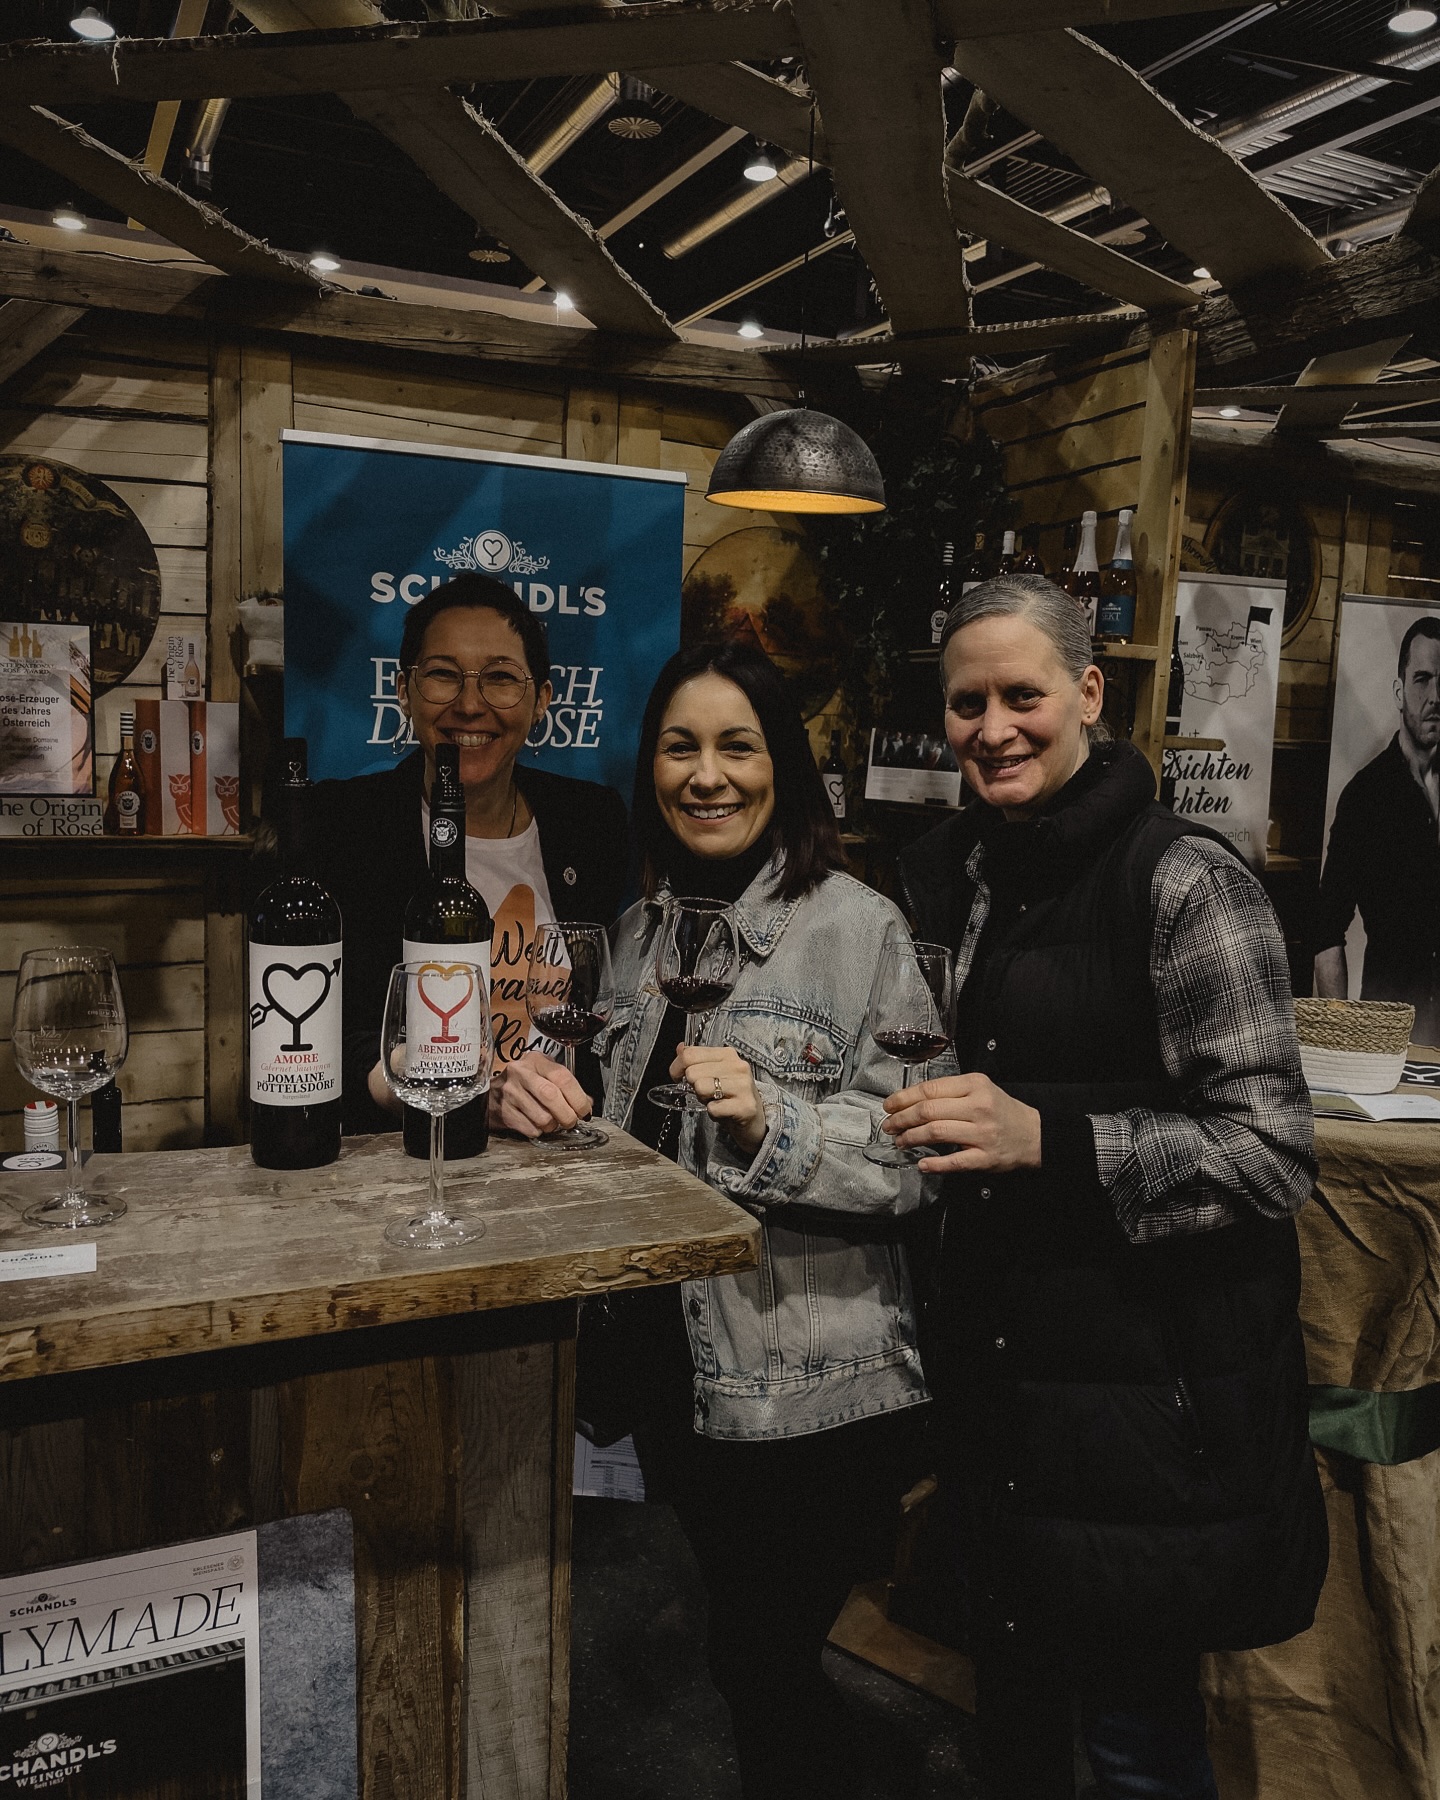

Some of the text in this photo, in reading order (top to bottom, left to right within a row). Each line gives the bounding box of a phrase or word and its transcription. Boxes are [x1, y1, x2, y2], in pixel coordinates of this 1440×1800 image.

[370, 571, 607, 616] SCDL'S
[1102, 611, 1121, 621] SEKT
[0, 693, 60, 705] osé-Erzeuger
[1, 706, 51, 715] des Jahres
[2, 716, 50, 727] Österreich
[525, 699, 604, 748] OSÉ
[0, 798, 102, 822] he Origin
[22, 818, 44, 836] of
[51, 818, 103, 836] Rosé
[417, 1043, 471, 1054] ABENDROT
[274, 1053, 319, 1064] AMORE
[420, 1059, 468, 1069] DOMAINE
[260, 1062, 292, 1072] Cabernet
[267, 1071, 325, 1083] DOMAINE
[257, 1078, 335, 1093] PÖTTELSDORF
[193, 1562, 224, 1572] ERLESENER
[0, 1582, 243, 1676] LYMADE
[0, 1739, 117, 1781] CHANDL'S
[16, 1764, 82, 1788] WEINGUT
